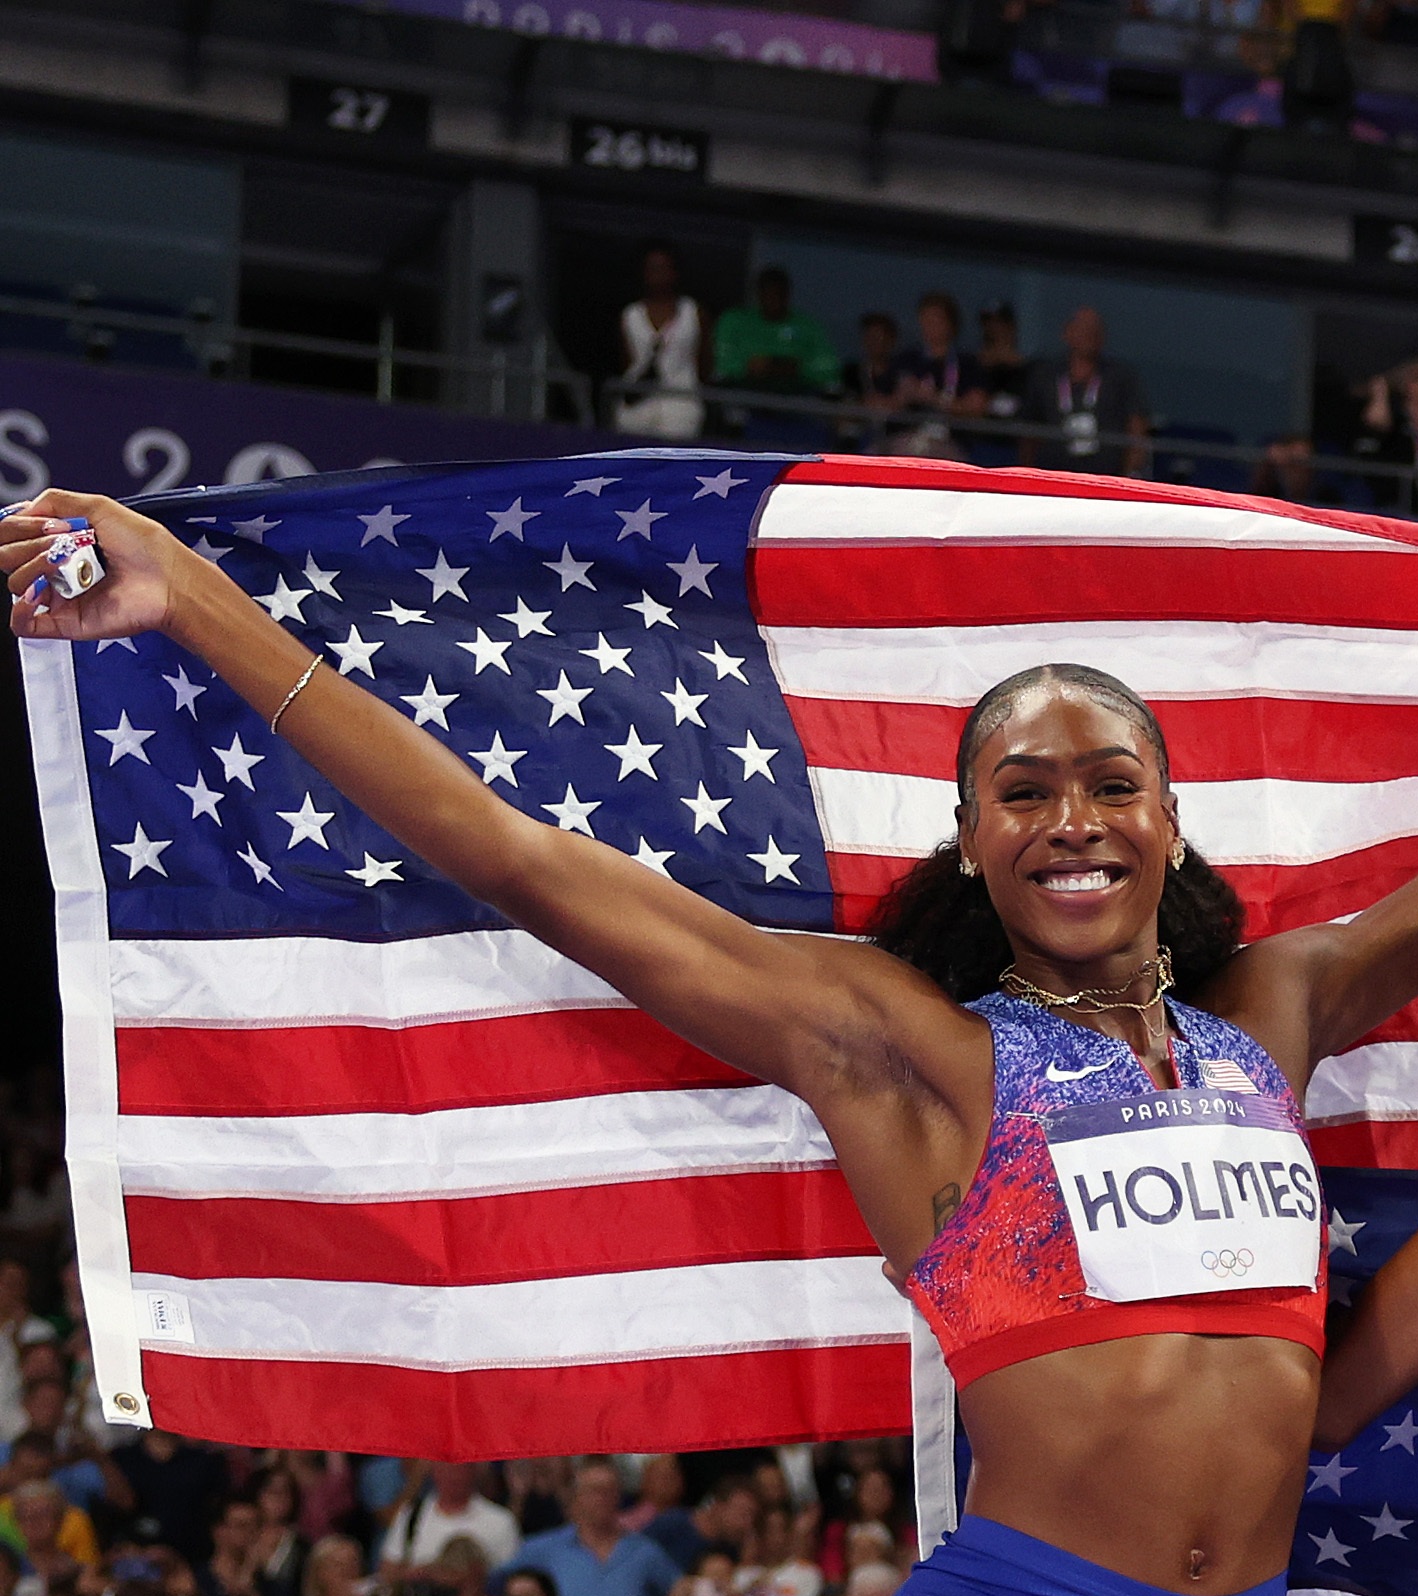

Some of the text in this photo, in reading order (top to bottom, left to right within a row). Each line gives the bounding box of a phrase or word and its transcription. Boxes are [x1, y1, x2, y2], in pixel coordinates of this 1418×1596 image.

[329, 89, 391, 132] 27
[1199, 1098, 1246, 1118] 2024
[1074, 1159, 1317, 1232] HOLMES
